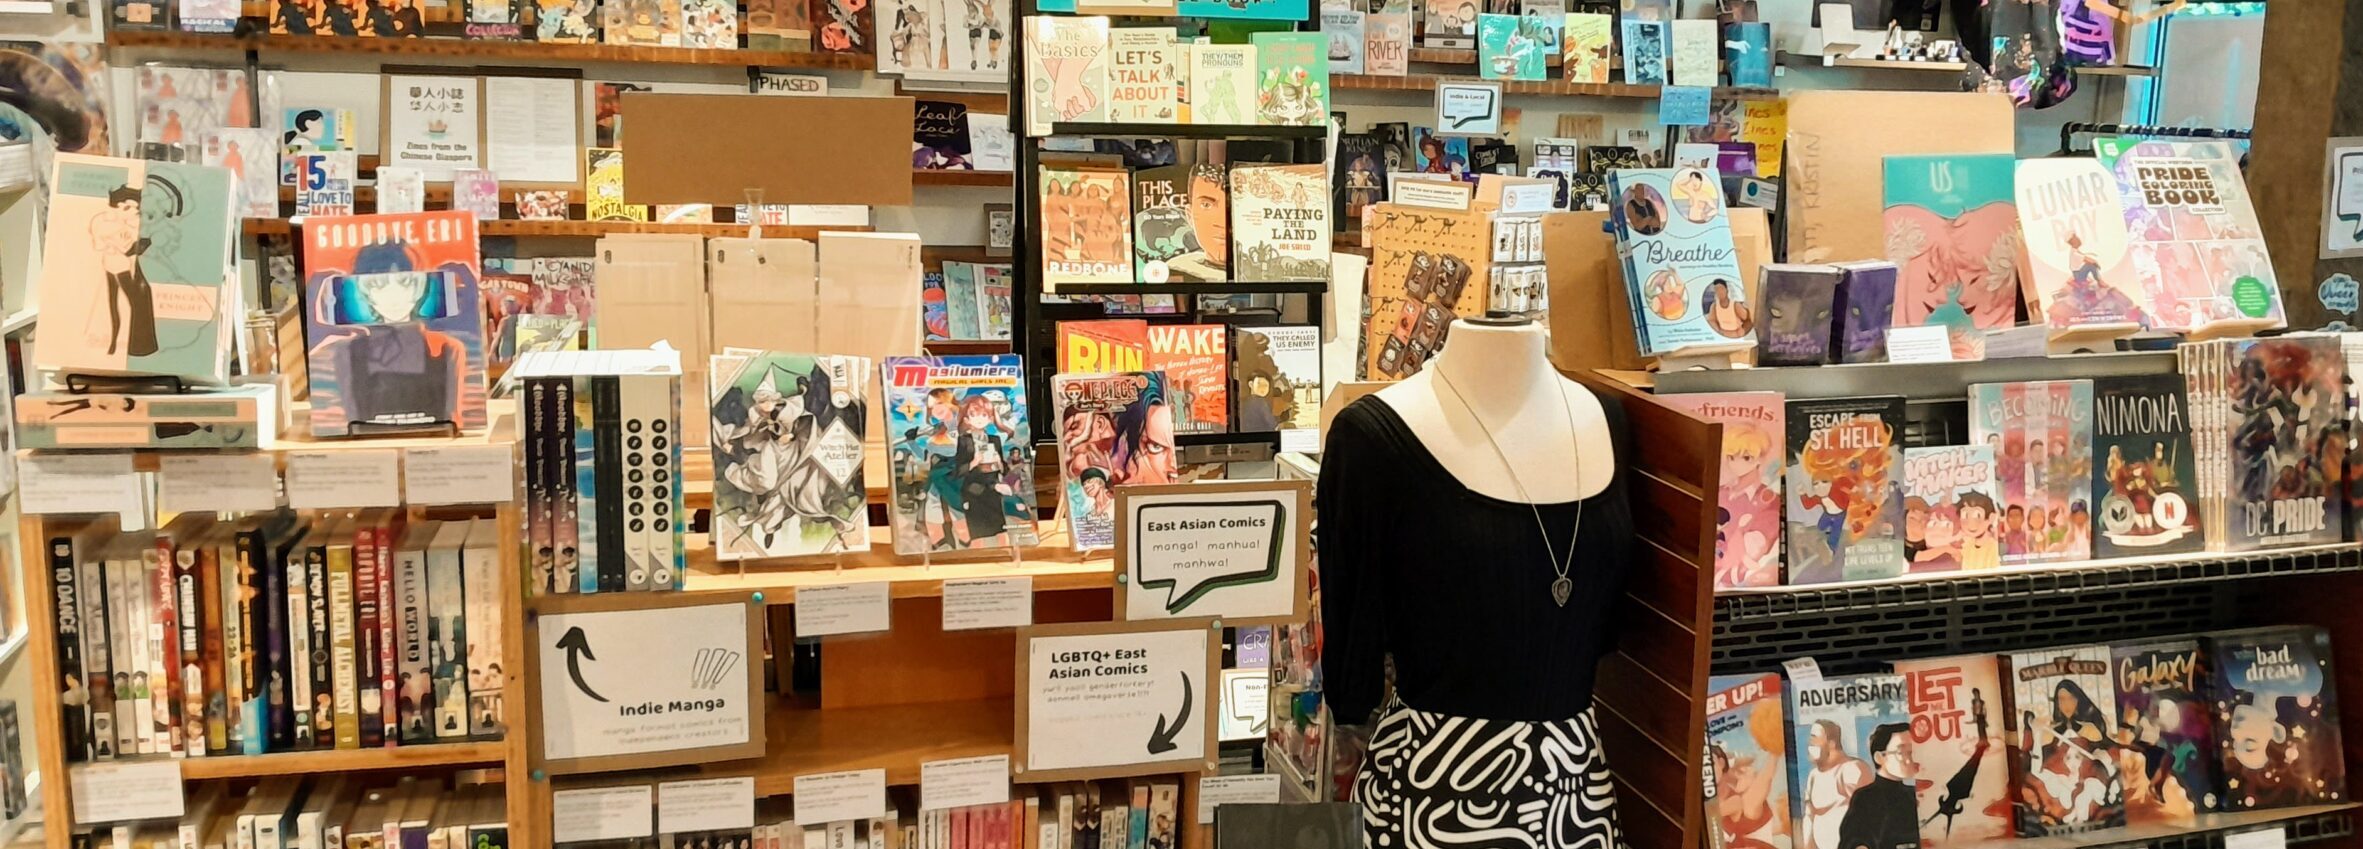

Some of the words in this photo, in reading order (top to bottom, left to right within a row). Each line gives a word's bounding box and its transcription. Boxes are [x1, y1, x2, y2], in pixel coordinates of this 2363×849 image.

[1056, 29, 1081, 41] The
[1041, 42, 1098, 57] Basics
[1116, 51, 1162, 64] LET'S
[1368, 41, 1403, 60] RIVER
[759, 77, 819, 92] PHASED
[1118, 69, 1160, 83] TALK
[1112, 87, 1169, 101] ABOUT
[1133, 105, 1148, 118] IT
[298, 156, 326, 191] 15
[1804, 133, 1820, 210] KRISTIN
[1930, 161, 1952, 192] US
[2137, 167, 2210, 180] PRIDE
[1140, 180, 1173, 195] THIS
[2141, 181, 2213, 189] COLORING
[312, 191, 337, 204] LOVE
[339, 191, 352, 204] TO
[1143, 194, 1190, 209] PLACE
[2026, 171, 2109, 221] LUNAR
[2144, 190, 2220, 205] BOOK
[591, 202, 643, 221] NOSTALGIA
[758, 212, 782, 224] ATE
[1263, 208, 1324, 221] PAYING
[317, 220, 420, 248] GOODBYE,
[426, 218, 462, 243] ERI
[1272, 228, 1317, 241] LAND
[2051, 209, 2098, 251] BOY
[1632, 240, 1735, 264] Breathe
[1049, 262, 1128, 276] REDBONE
[1149, 327, 1226, 355] WAKE
[1067, 333, 1143, 373] RUN
[892, 364, 1016, 387] Magilumiere
[1698, 402, 1780, 422] friends.
[1809, 412, 1855, 429] ESCAPE
[2096, 393, 2183, 436] NIMONA
[819, 443, 844, 452] Witch
[845, 441, 859, 451] Hat
[1810, 429, 1834, 450] ST.
[1839, 427, 1883, 449] HELL
[824, 450, 857, 461] Atelier
[836, 468, 847, 478] 12
[1915, 462, 1988, 496] MAKER
[2164, 502, 2175, 519] N
[2246, 502, 2268, 537] DC
[2273, 497, 2326, 534] PRIDE
[1148, 521, 1176, 532] East
[1179, 519, 1215, 530] Asian
[1219, 516, 1266, 528] Comics
[1153, 540, 1198, 552] manga!
[1207, 539, 1260, 550] manhua!
[1173, 558, 1228, 569] manhwa!
[56, 567, 72, 582] 10
[309, 564, 323, 597] DEMON
[404, 560, 416, 603] HELLO
[57, 585, 77, 634] DANCE
[311, 598, 325, 632] SLAYER
[331, 572, 351, 643] FULLMETAL
[406, 609, 418, 659] WORLD
[1051, 651, 1111, 663] LGBTQ+
[1115, 648, 1147, 659] East
[2256, 644, 2292, 665] bad
[1049, 666, 1090, 679] Asian
[1095, 662, 1148, 676] Comics
[2069, 661, 2105, 673] QUEEN
[2120, 651, 2196, 692] Galaxy
[2246, 662, 2301, 682] dream
[334, 647, 354, 714] ALCHEMIST
[1906, 666, 1963, 714] LET
[1731, 680, 1765, 706] UP!
[1800, 683, 1903, 707] ADVERSARY
[620, 701, 663, 716] Indie
[668, 697, 725, 713] Manga
[1909, 710, 1965, 744] OUT
